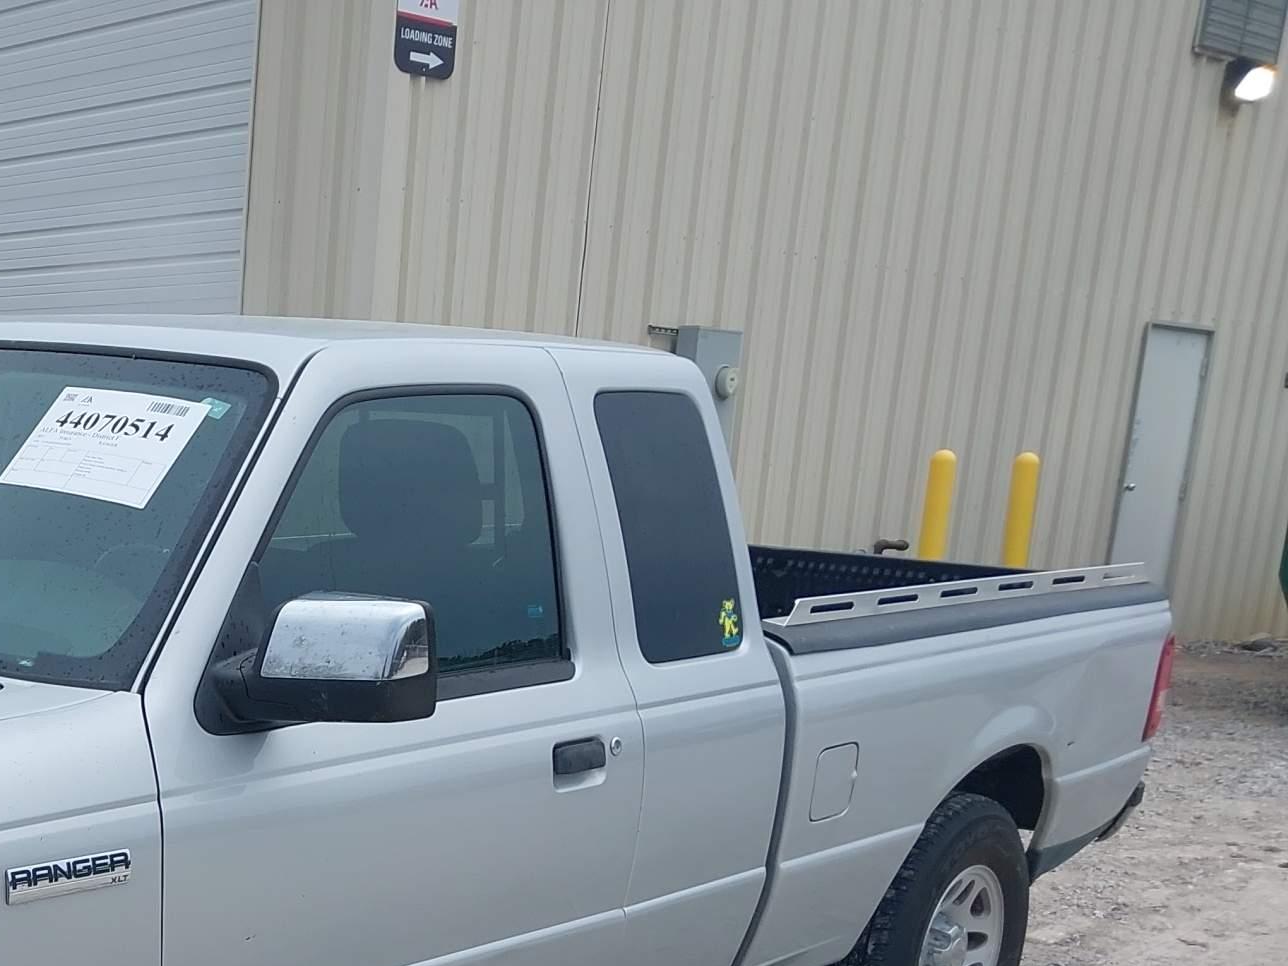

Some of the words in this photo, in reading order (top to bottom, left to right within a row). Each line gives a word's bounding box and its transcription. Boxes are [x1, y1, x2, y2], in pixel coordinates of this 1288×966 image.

[400, 27, 432, 44] LOADING
[433, 34, 453, 48] ZONE
[55, 410, 176, 442] 44070514
[10, 851, 131, 890] RANGER
[110, 874, 129, 884] XLT
